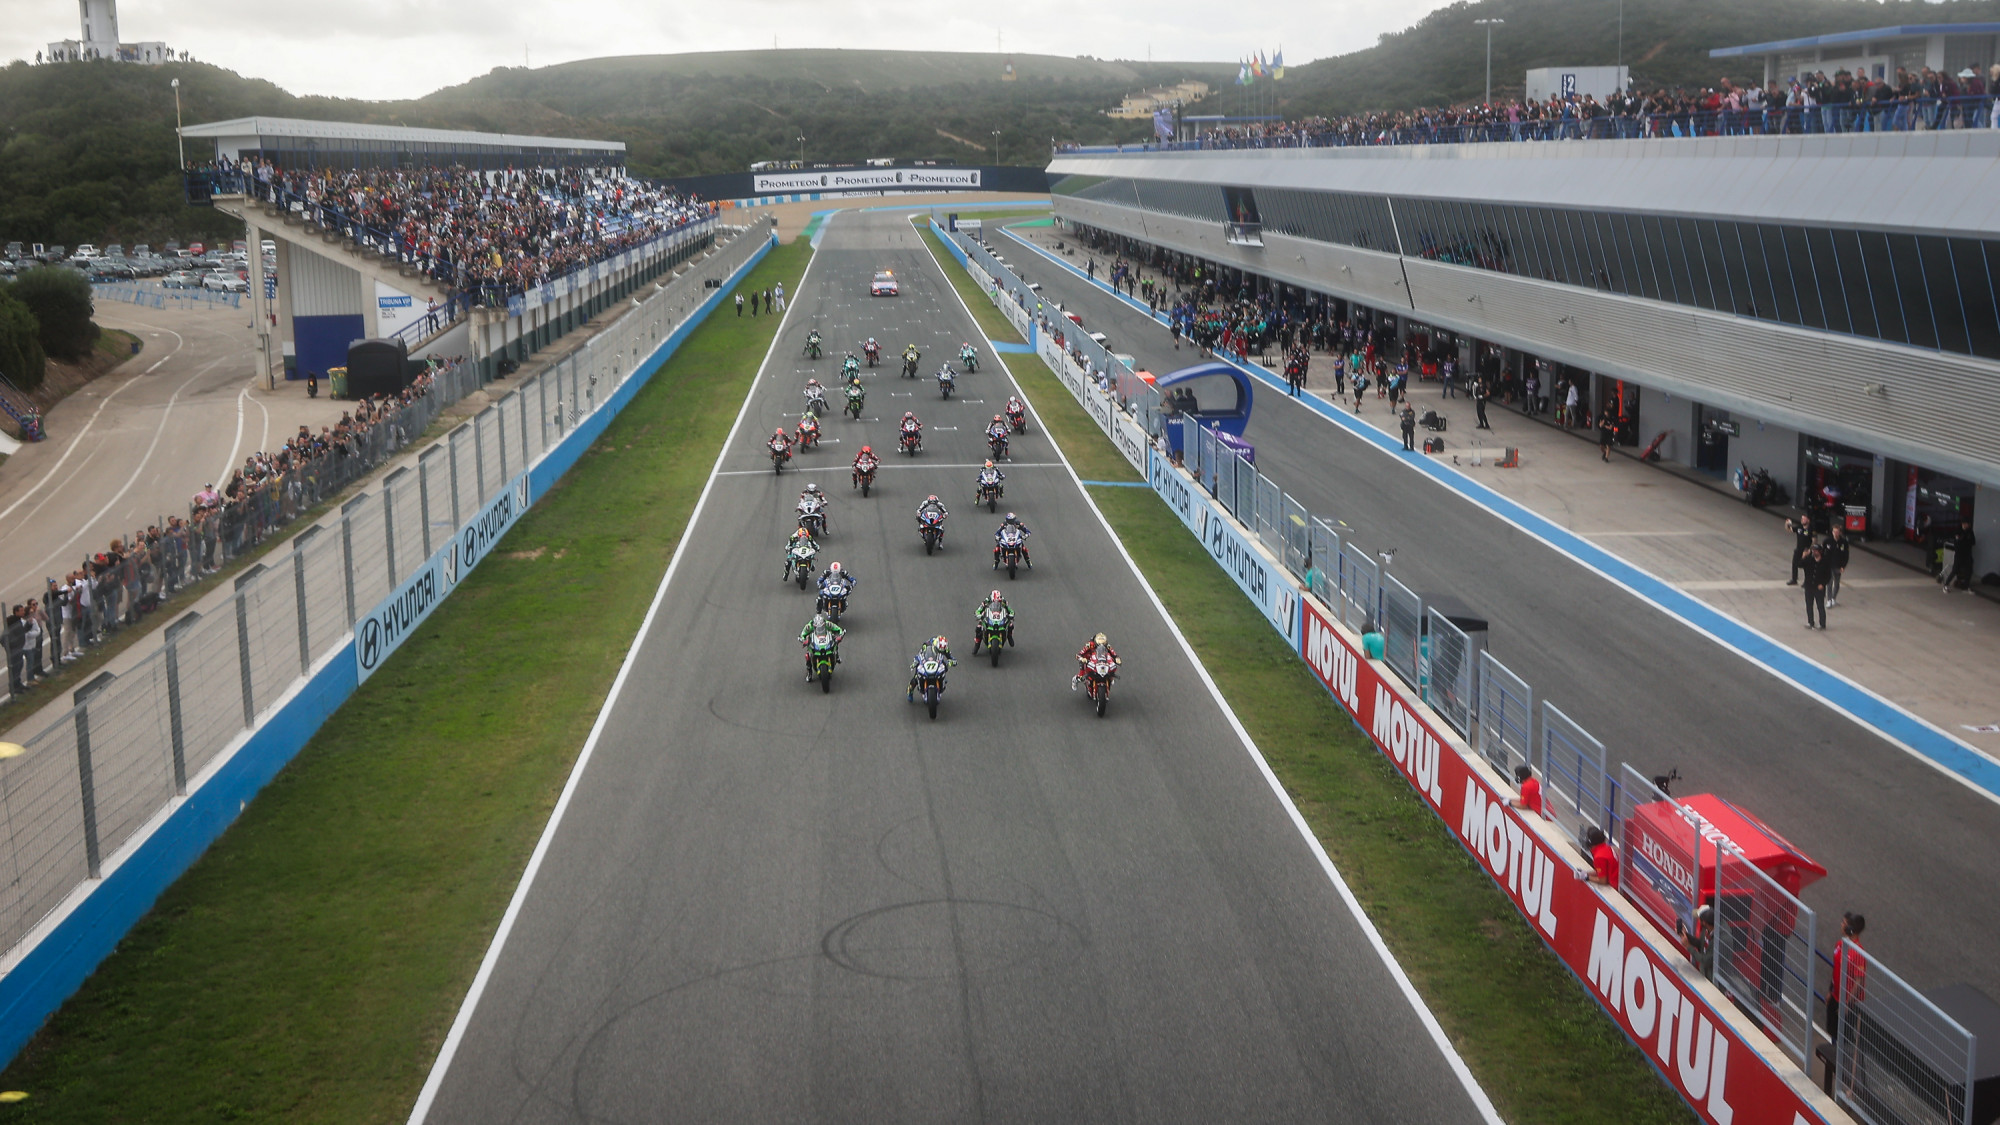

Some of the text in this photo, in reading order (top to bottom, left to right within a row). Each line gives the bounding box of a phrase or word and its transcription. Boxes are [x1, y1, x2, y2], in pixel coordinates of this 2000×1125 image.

[759, 173, 969, 188] PROMETEON PROMETEON PROMETEON
[477, 491, 512, 551] HYUNDAI
[1163, 467, 1191, 521] HYUNDAI
[383, 568, 436, 647] HYUNDAI
[1226, 533, 1267, 607] HYUNDAI
[1306, 612, 1359, 715] MOTUL
[1372, 681, 1443, 808] MOTUL
[1461, 774, 1558, 941] MOTUL
[1642, 831, 1694, 897] HONDA
[1586, 907, 1734, 1125] MOTUL
